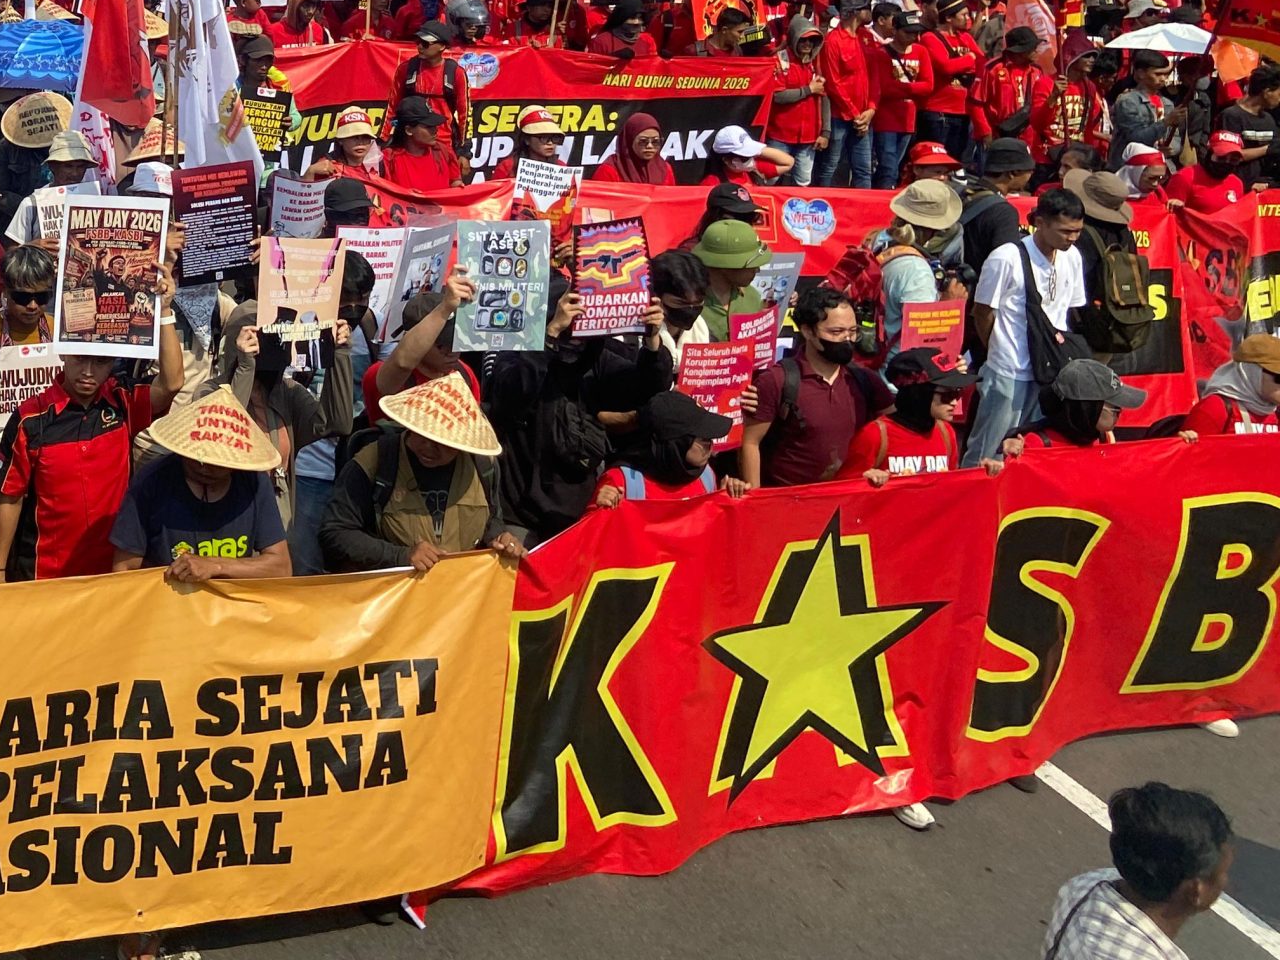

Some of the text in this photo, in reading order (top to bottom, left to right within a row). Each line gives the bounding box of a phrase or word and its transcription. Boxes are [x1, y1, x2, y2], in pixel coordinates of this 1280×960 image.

[602, 73, 750, 90] HARI BURUH SEDUNIA 2026
[244, 106, 283, 120] BERSATU
[344, 113, 366, 122] KSN
[477, 104, 618, 134] SEERA:
[20, 115, 59, 129] AGRARIA
[26, 124, 60, 136] SEJATI
[520, 159, 555, 175] Tangkap,
[519, 168, 563, 183] Penjarakan
[516, 184, 556, 197] Pelanggar
[70, 209, 102, 230] MAY
[104, 210, 130, 229] DAY
[131, 211, 162, 233] 2026
[85, 228, 144, 242] FSBB-KASBI
[467, 228, 542, 242] SITA ASET-
[100, 304, 127, 313] NOTA
[686, 346, 730, 357] Sita Seluruh
[685, 357, 737, 368] Koruptor serta
[683, 366, 730, 377] Konglomerat
[682, 376, 731, 387] Pengemplang
[198, 404, 250, 427] TANAH
[196, 417, 251, 439] UNTUK
[190, 430, 254, 453] RAKYAT
[195, 658, 439, 737] SEJATI
